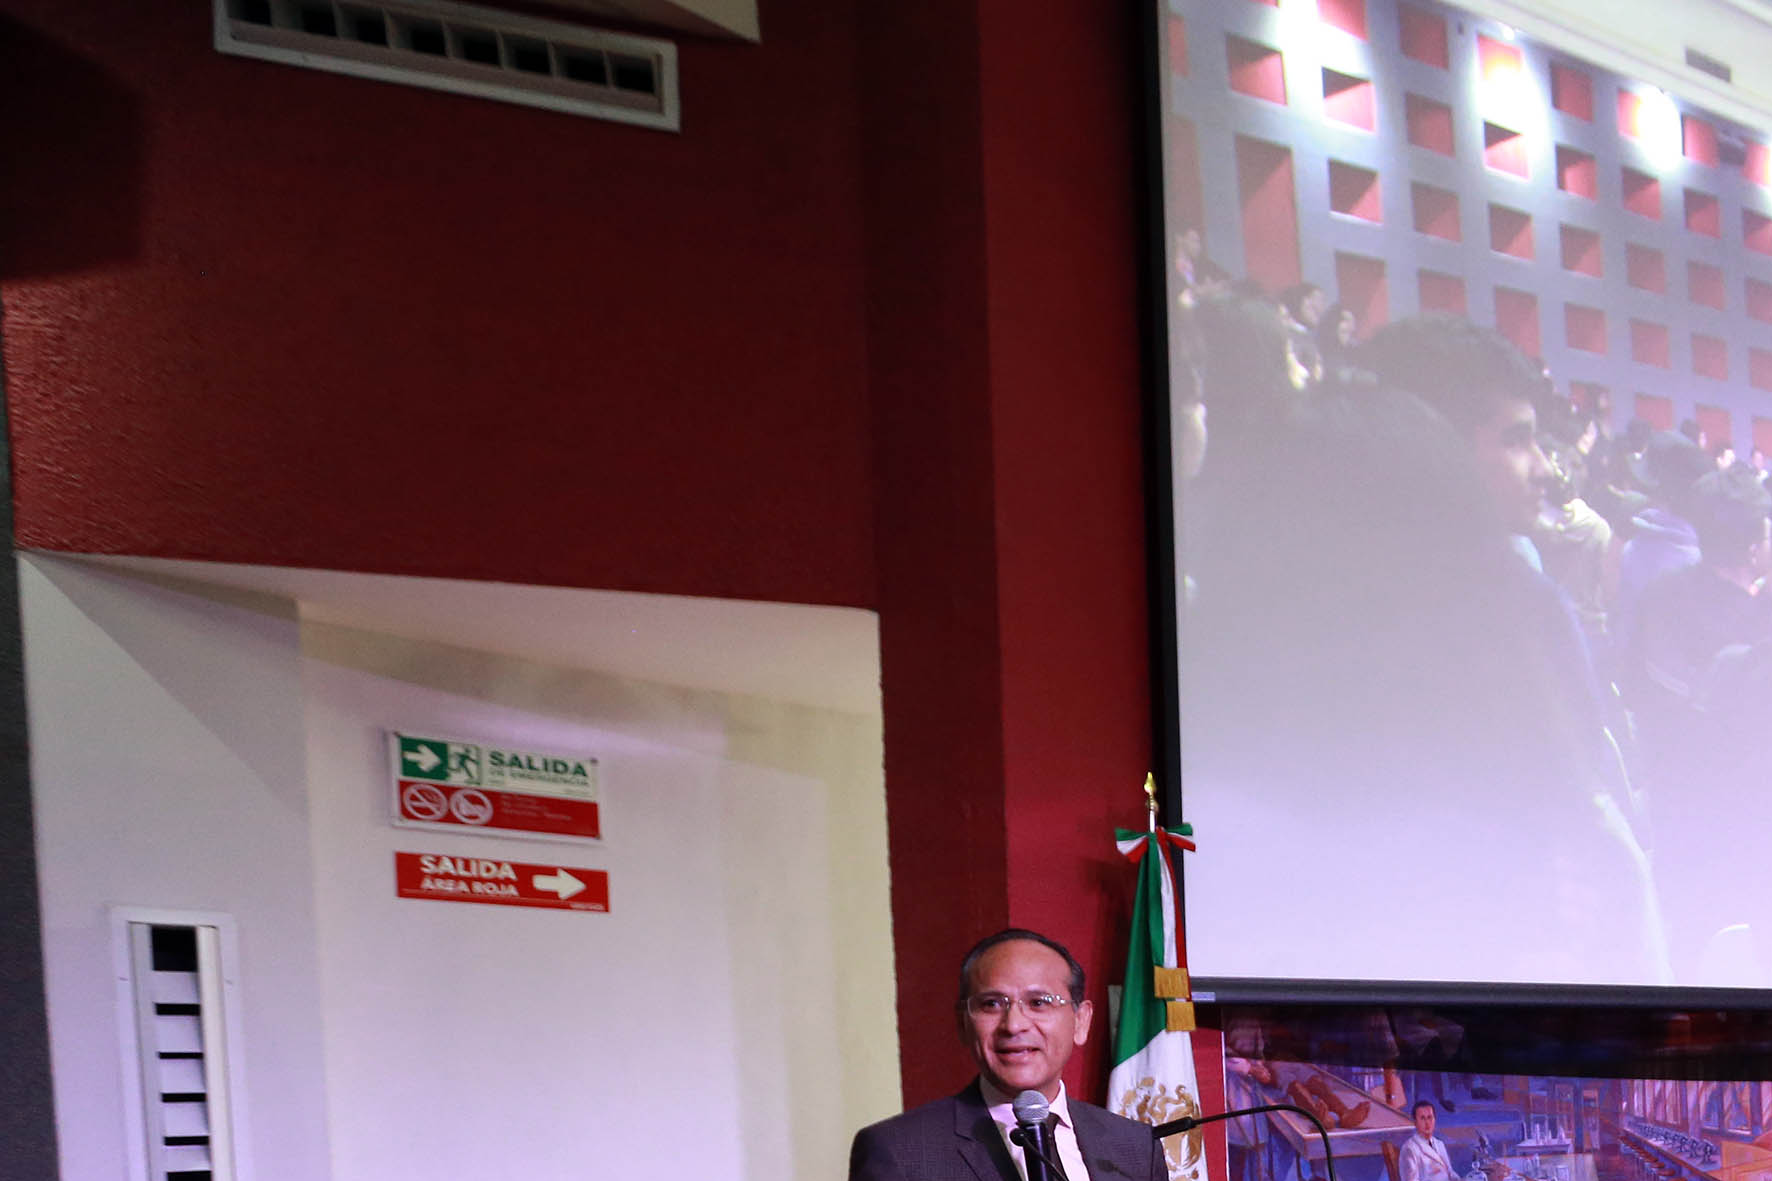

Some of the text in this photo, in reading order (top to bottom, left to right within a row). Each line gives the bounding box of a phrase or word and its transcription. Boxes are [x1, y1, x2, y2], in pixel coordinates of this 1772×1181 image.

[489, 750, 588, 777] SALIDA
[420, 854, 518, 881] SALIDA
[471, 880, 521, 897] ROJA
